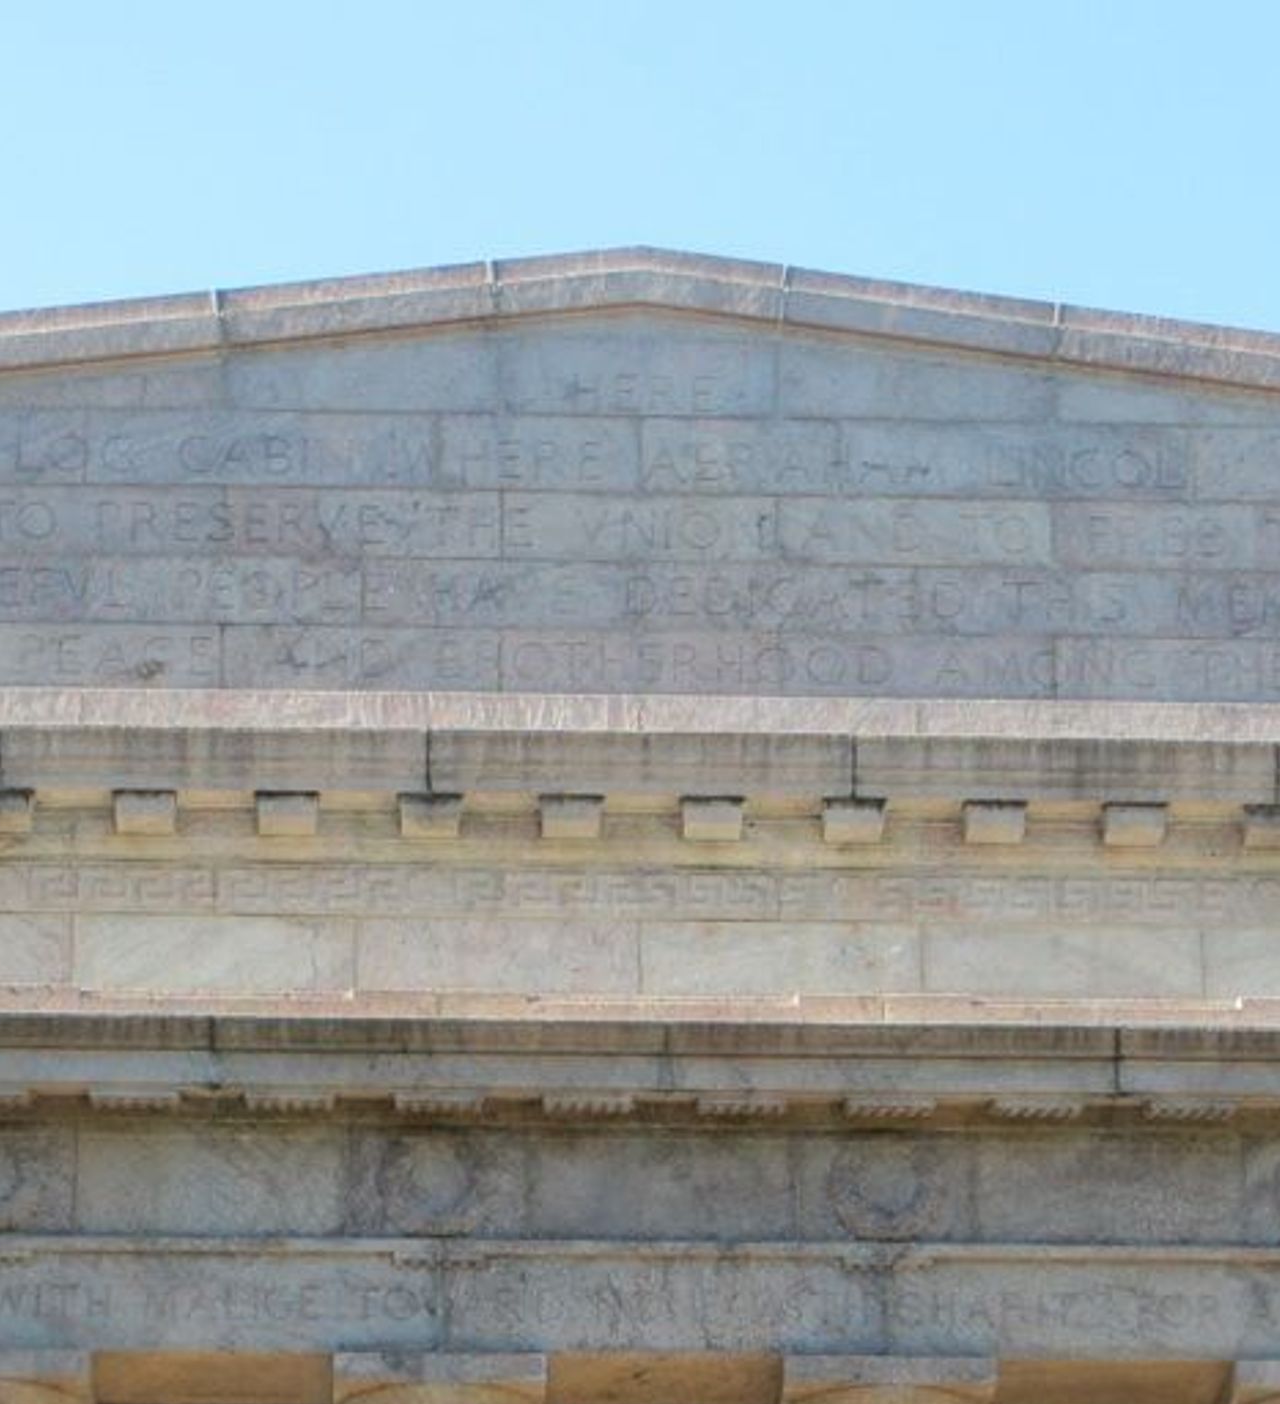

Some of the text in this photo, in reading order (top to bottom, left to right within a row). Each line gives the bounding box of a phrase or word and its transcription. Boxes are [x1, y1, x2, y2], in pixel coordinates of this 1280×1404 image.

[567, 374, 718, 413] HERE
[14, 432, 138, 474] LOG
[178, 434, 354, 476] CABIN
[398, 437, 602, 482] WHERE
[987, 446, 1232, 490] LINCOL
[93, 500, 387, 545] PRESERVE
[423, 504, 536, 548] THE
[802, 510, 926, 553] AND
[958, 513, 1031, 556] TO
[179, 569, 387, 612] PEOPLE
[431, 573, 580, 616] HAE
[625, 575, 966, 621] DEDICATED
[1001, 580, 1128, 622] THIS
[15, 634, 215, 679] PEACE
[435, 639, 894, 687] BROTHERHOOD
[934, 648, 1160, 691] AMONG
